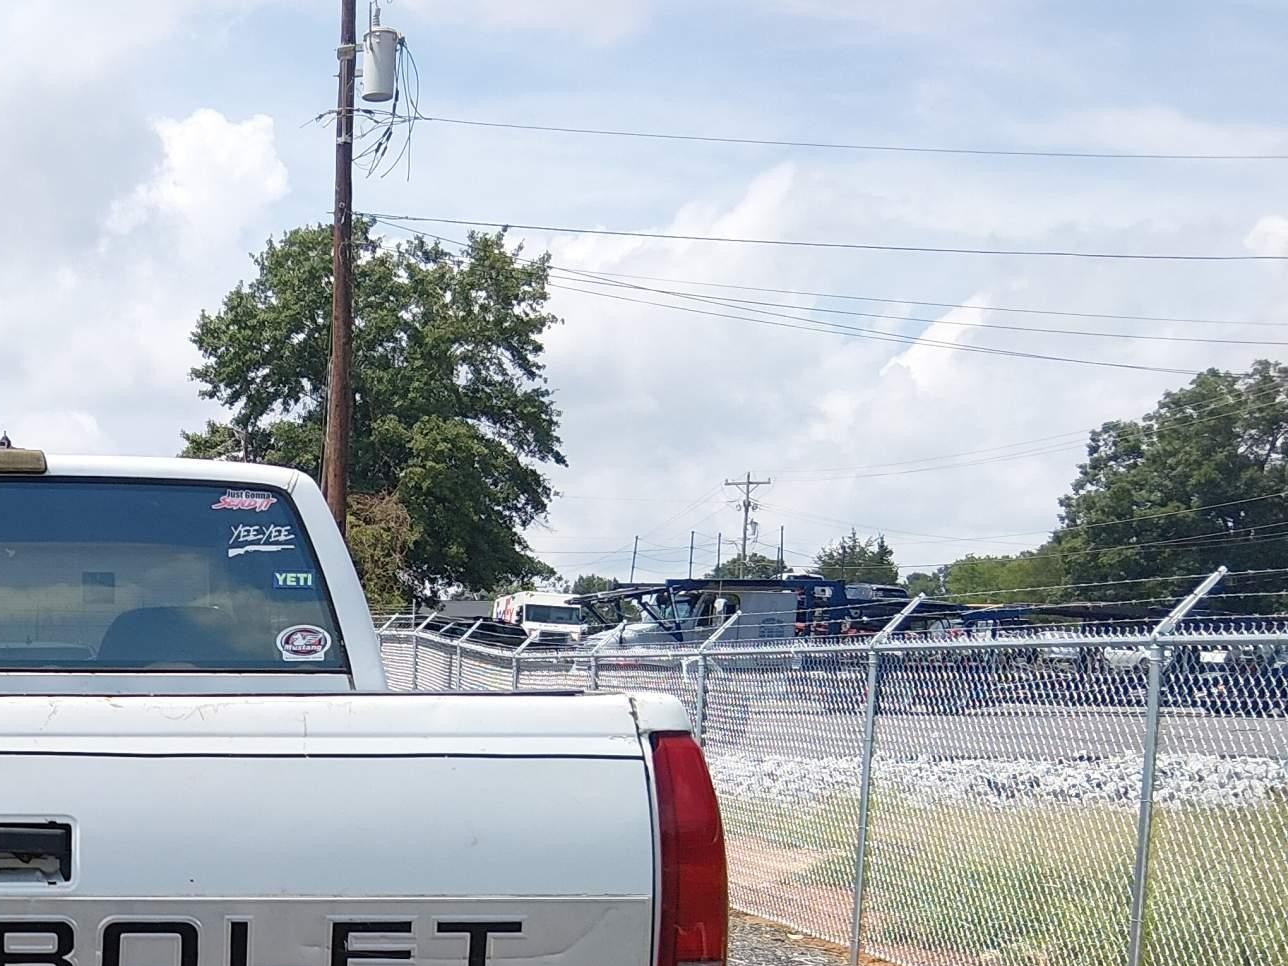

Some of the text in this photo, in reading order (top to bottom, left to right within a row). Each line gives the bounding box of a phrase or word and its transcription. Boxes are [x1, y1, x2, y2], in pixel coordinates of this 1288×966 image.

[227, 490, 271, 500] Just Gonna
[229, 524, 295, 544] YEE YEE
[274, 573, 312, 586] YETI
[284, 644, 322, 652] Mustang
